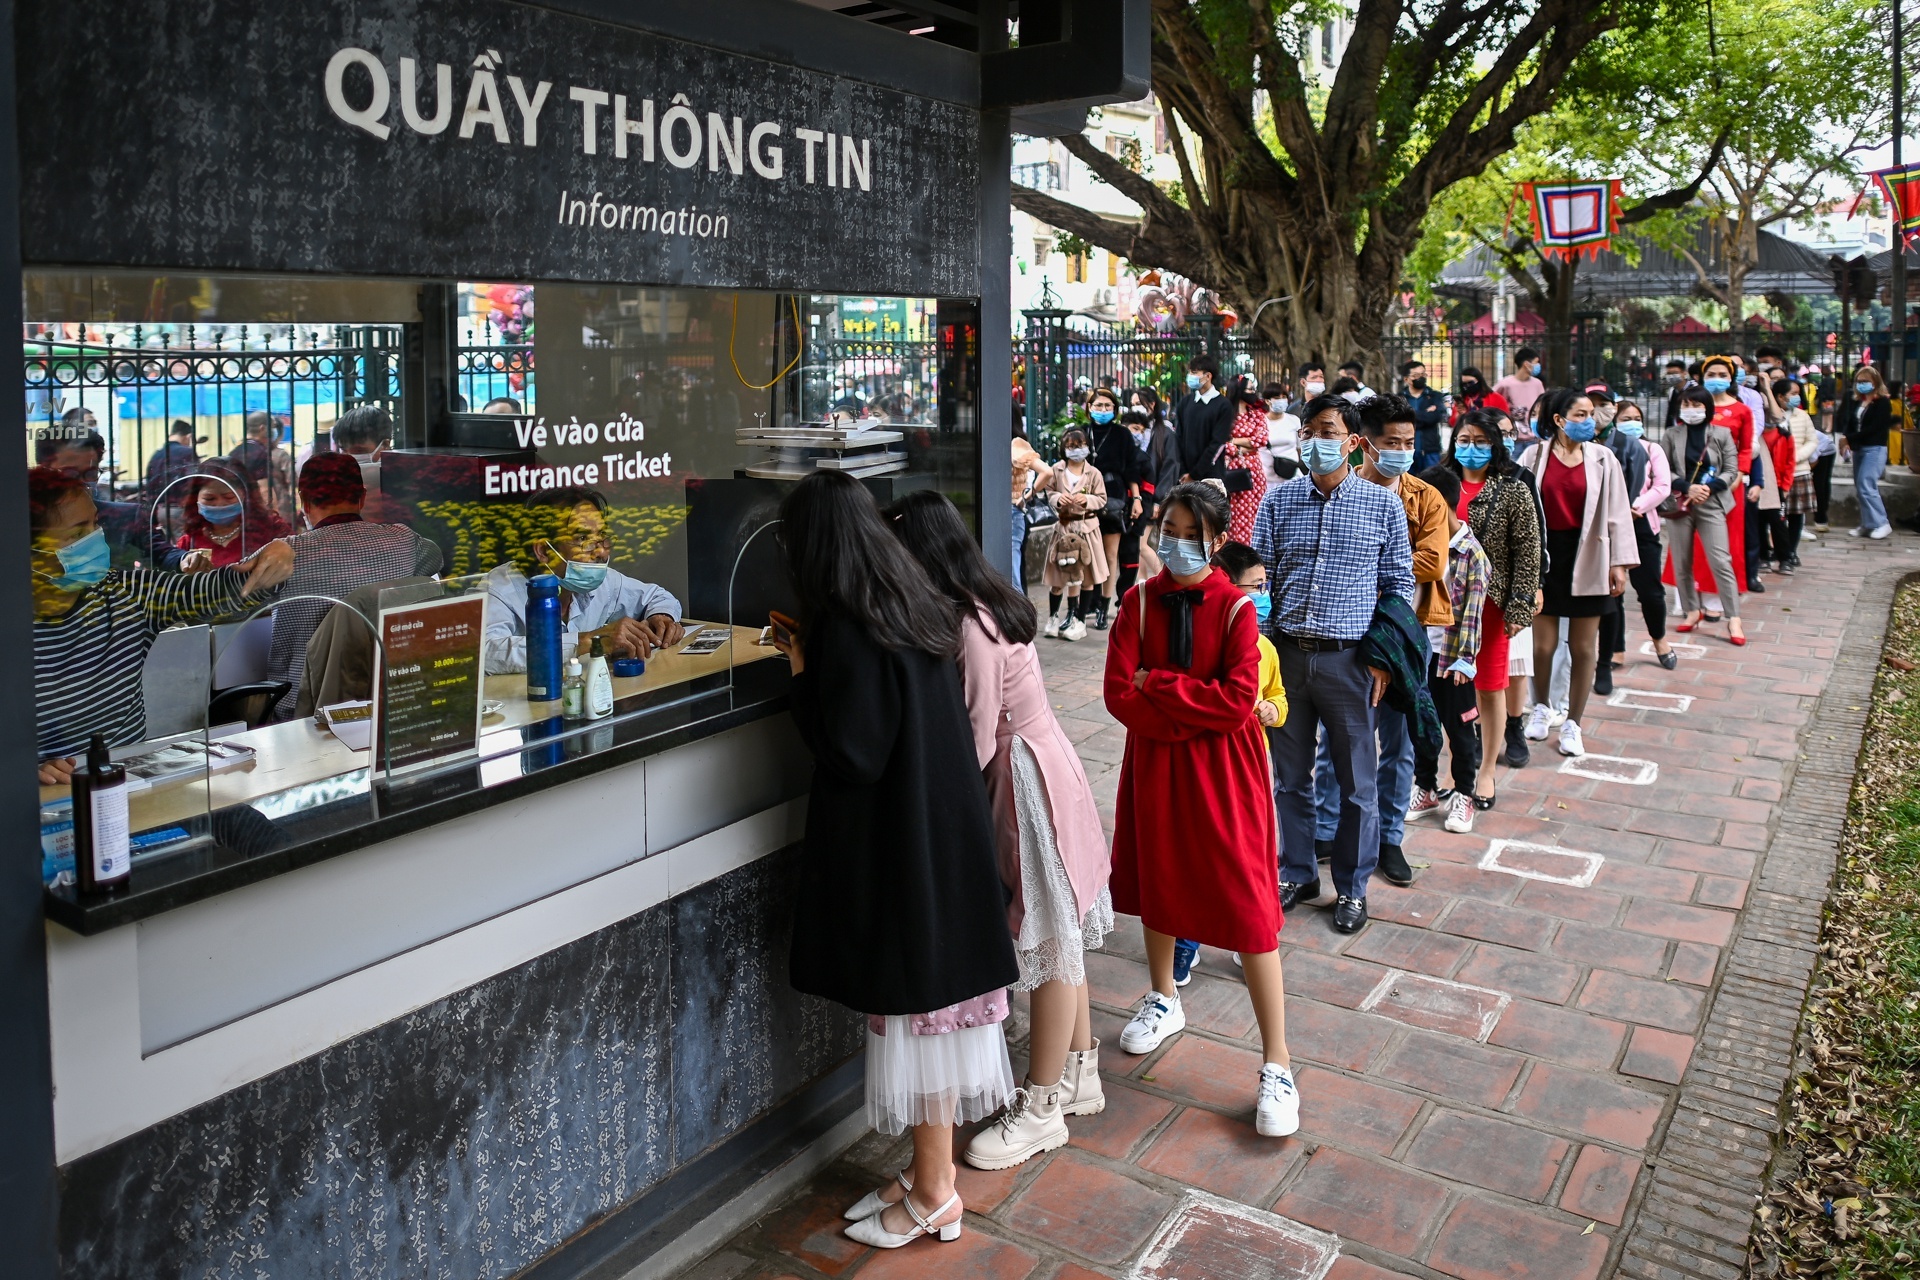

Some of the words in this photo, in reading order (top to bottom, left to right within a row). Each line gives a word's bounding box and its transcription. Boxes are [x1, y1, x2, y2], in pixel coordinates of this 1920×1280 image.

[324, 47, 552, 147] QUẦY
[569, 87, 783, 180] THÔNG
[795, 127, 871, 192] TIN
[557, 190, 730, 238] Information
[513, 417, 548, 449] Vé
[553, 416, 599, 446] vào
[603, 412, 645, 443] cửa
[484, 463, 599, 495] Entrance
[602, 451, 672, 482] Ticket
